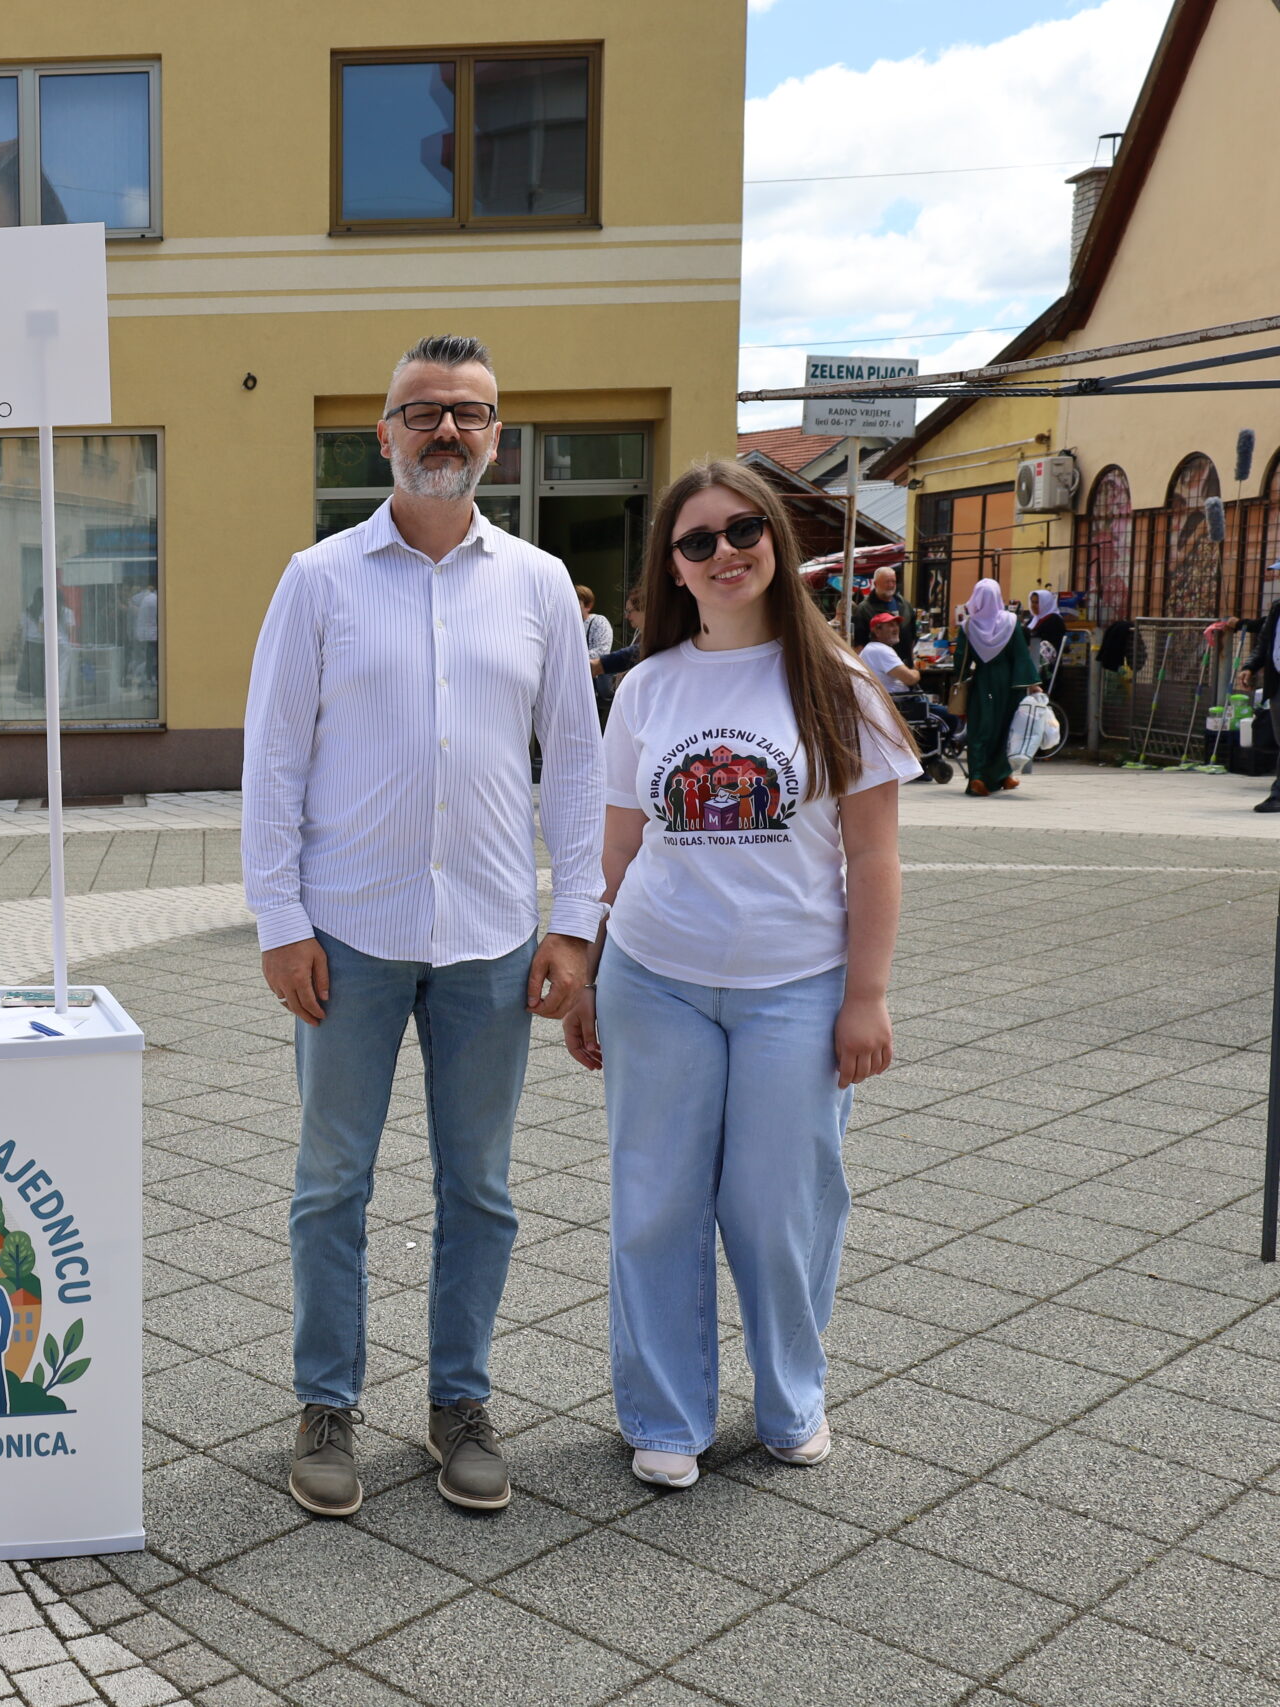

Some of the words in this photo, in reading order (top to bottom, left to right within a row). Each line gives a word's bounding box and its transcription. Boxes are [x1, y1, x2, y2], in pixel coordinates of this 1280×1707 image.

[811, 364, 864, 380] ZELENA
[867, 366, 914, 380] PIJACA
[828, 408, 857, 417] RADNO
[860, 409, 891, 418] VRIJEME
[650, 765, 665, 799] BIRAJ
[662, 734, 699, 764] SVOJU
[702, 728, 756, 743] MJESNU
[756, 737, 800, 795] ZAJEDNICU
[663, 836, 678, 846] TVOJ
[679, 836, 705, 846] GLAS.
[708, 835, 736, 845] TVOJA
[738, 834, 792, 845] ZAJEDNICA.
